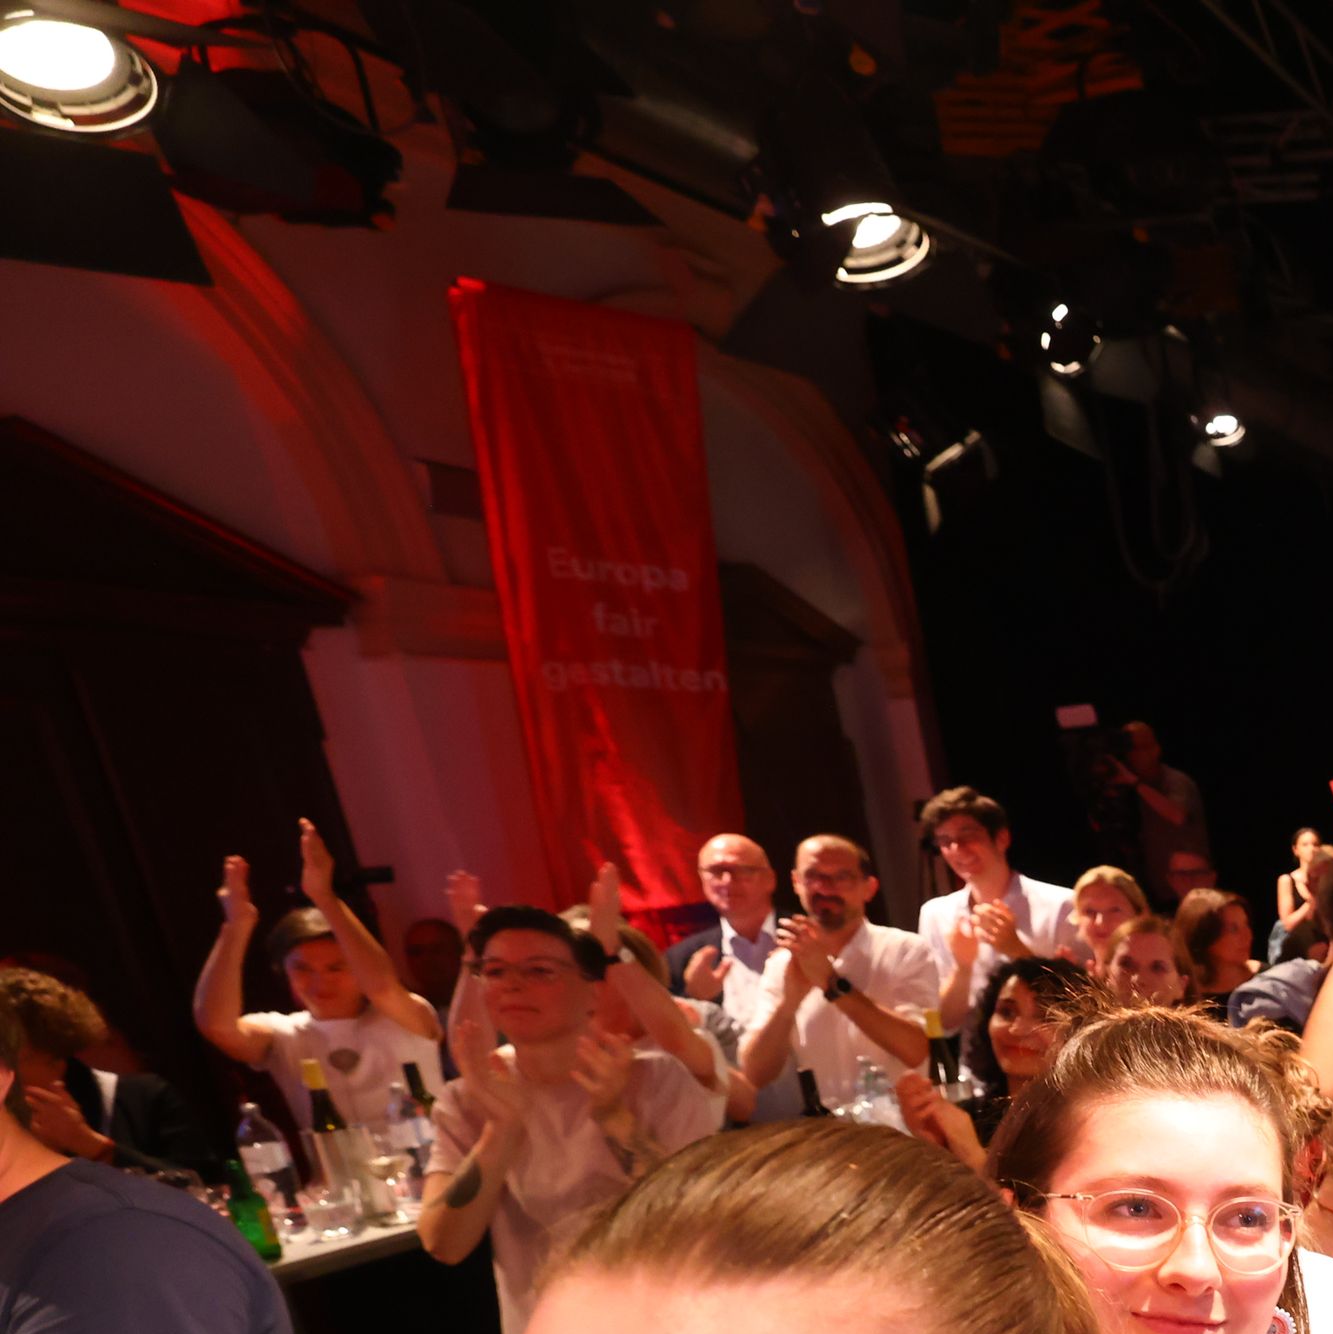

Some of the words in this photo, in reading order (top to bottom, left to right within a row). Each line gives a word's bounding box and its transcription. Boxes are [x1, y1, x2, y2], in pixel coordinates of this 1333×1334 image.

[546, 545, 690, 593] Europa
[592, 600, 658, 639] fair
[541, 658, 728, 692] gestalten
